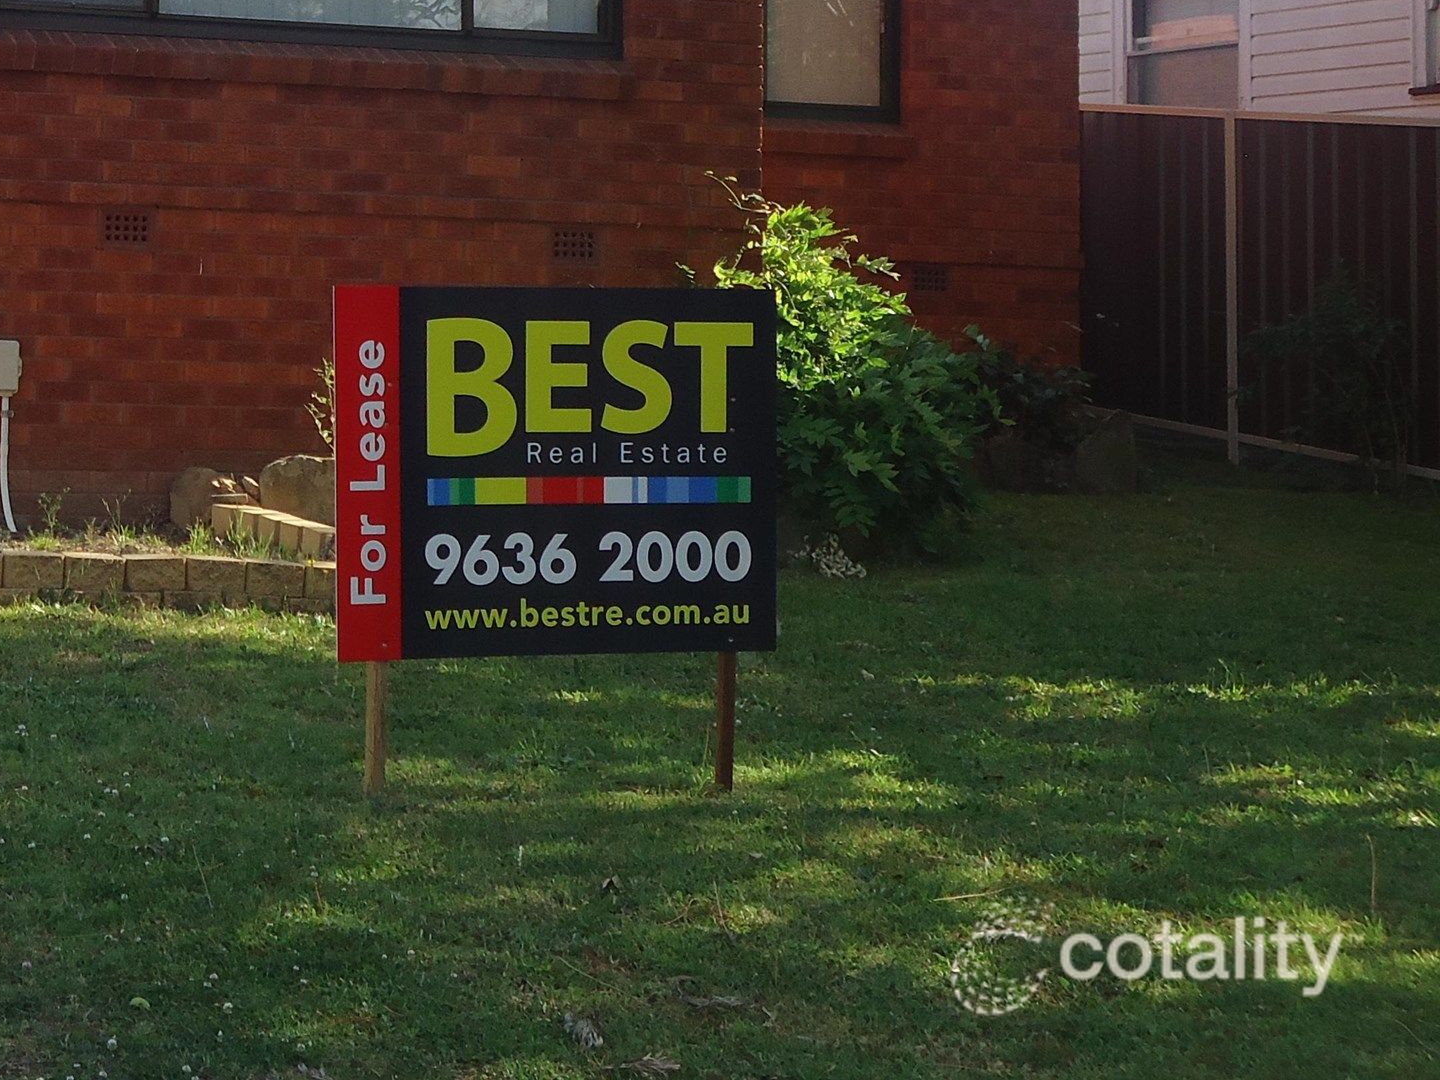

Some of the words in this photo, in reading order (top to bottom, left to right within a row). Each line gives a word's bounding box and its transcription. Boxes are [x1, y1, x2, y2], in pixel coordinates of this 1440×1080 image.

[349, 338, 386, 492] Lease
[426, 318, 755, 457] BEST
[527, 442, 598, 464] Real
[620, 441, 728, 464] Estate
[350, 514, 387, 606] For
[424, 532, 577, 586] 9636
[598, 530, 752, 583] 2000
[425, 598, 750, 630] www.bestre.com.au
